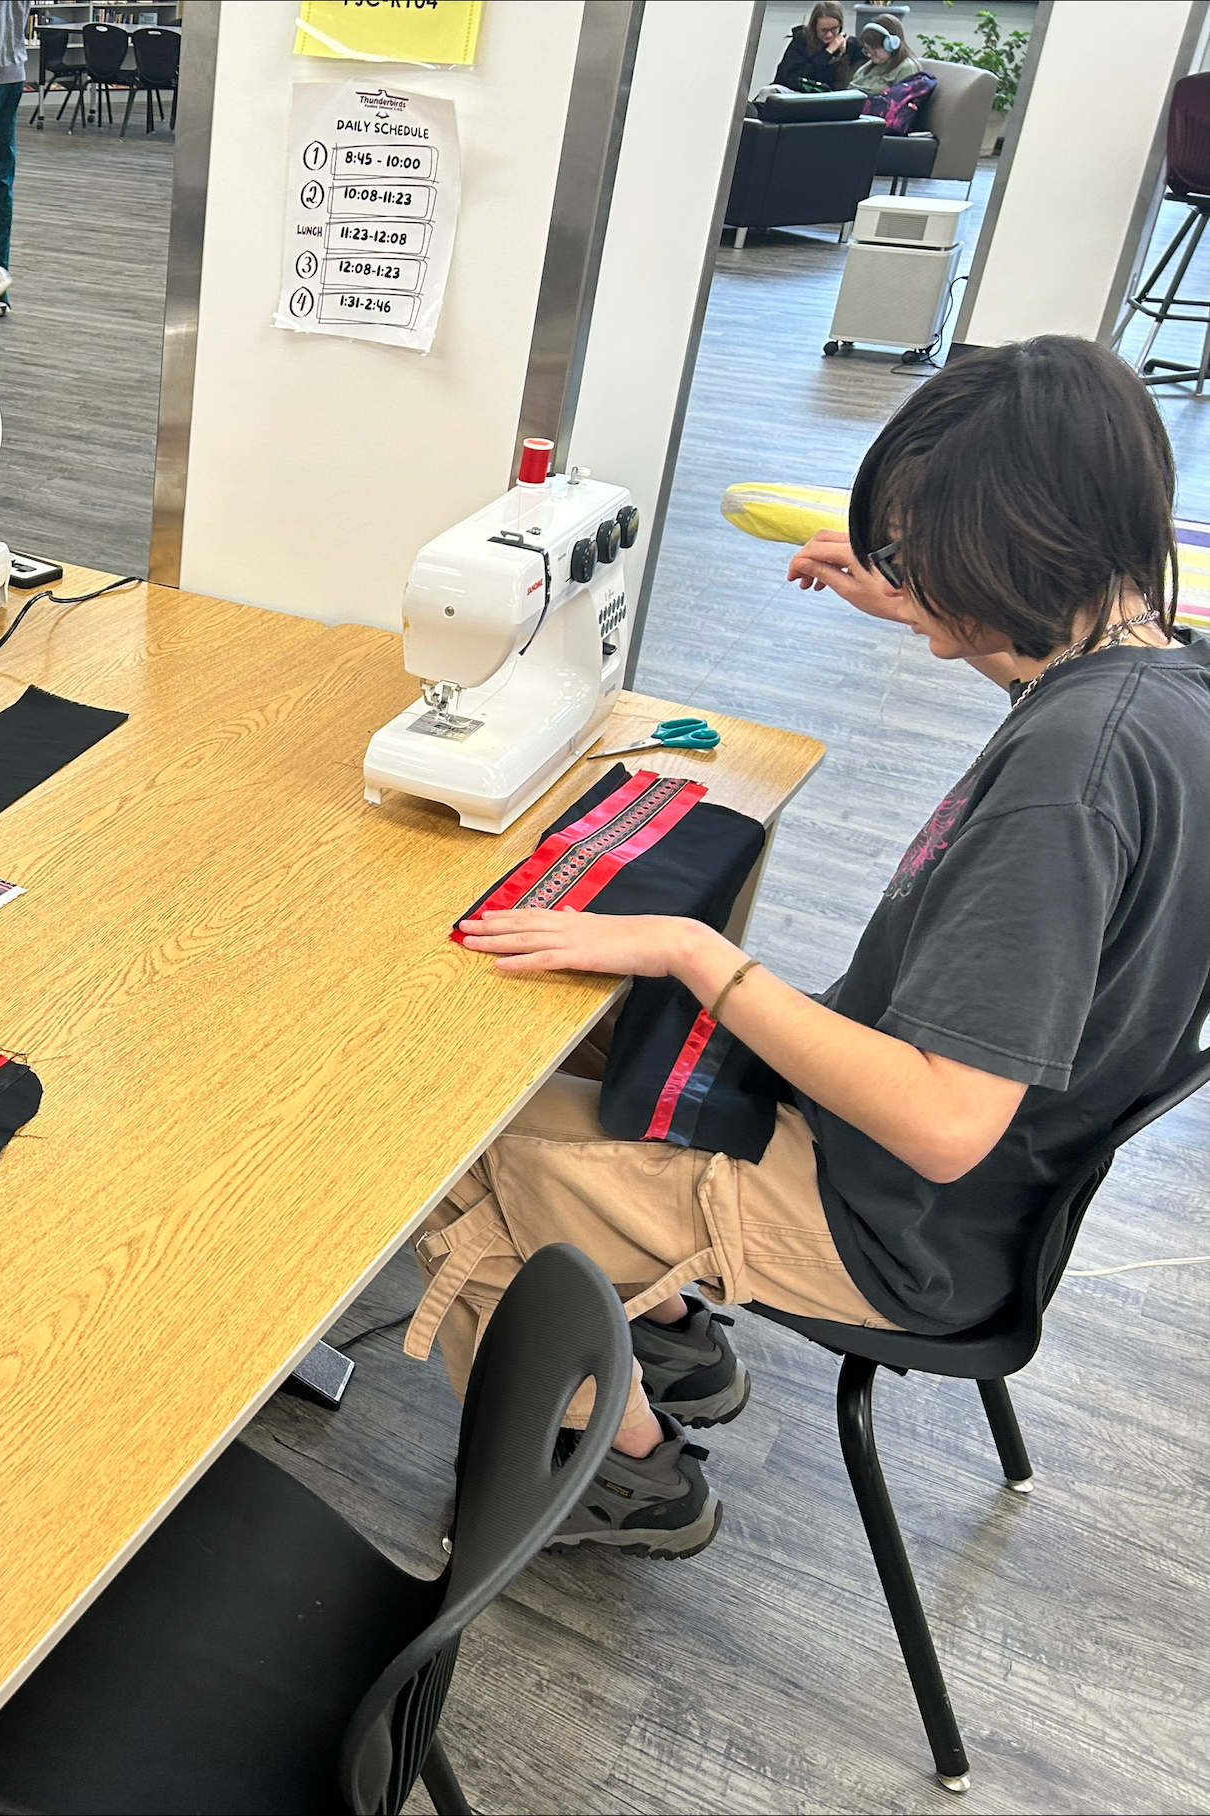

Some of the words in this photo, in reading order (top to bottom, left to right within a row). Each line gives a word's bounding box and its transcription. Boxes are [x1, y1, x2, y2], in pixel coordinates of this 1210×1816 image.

[360, 95, 406, 108] Thunderbirds
[336, 119, 371, 133] DAILY
[374, 122, 429, 140] SCHEDULE
[345, 151, 373, 166] 8:45
[386, 155, 421, 170] 10:00
[344, 187, 412, 206] 10:08-11:23
[297, 224, 323, 237] LUNCH
[340, 226, 407, 246] 11:23-12:08
[339, 260, 401, 279] 12:08-1:23
[340, 295, 392, 313] 1:31-2:46
[526, 577, 544, 596] JANOME
